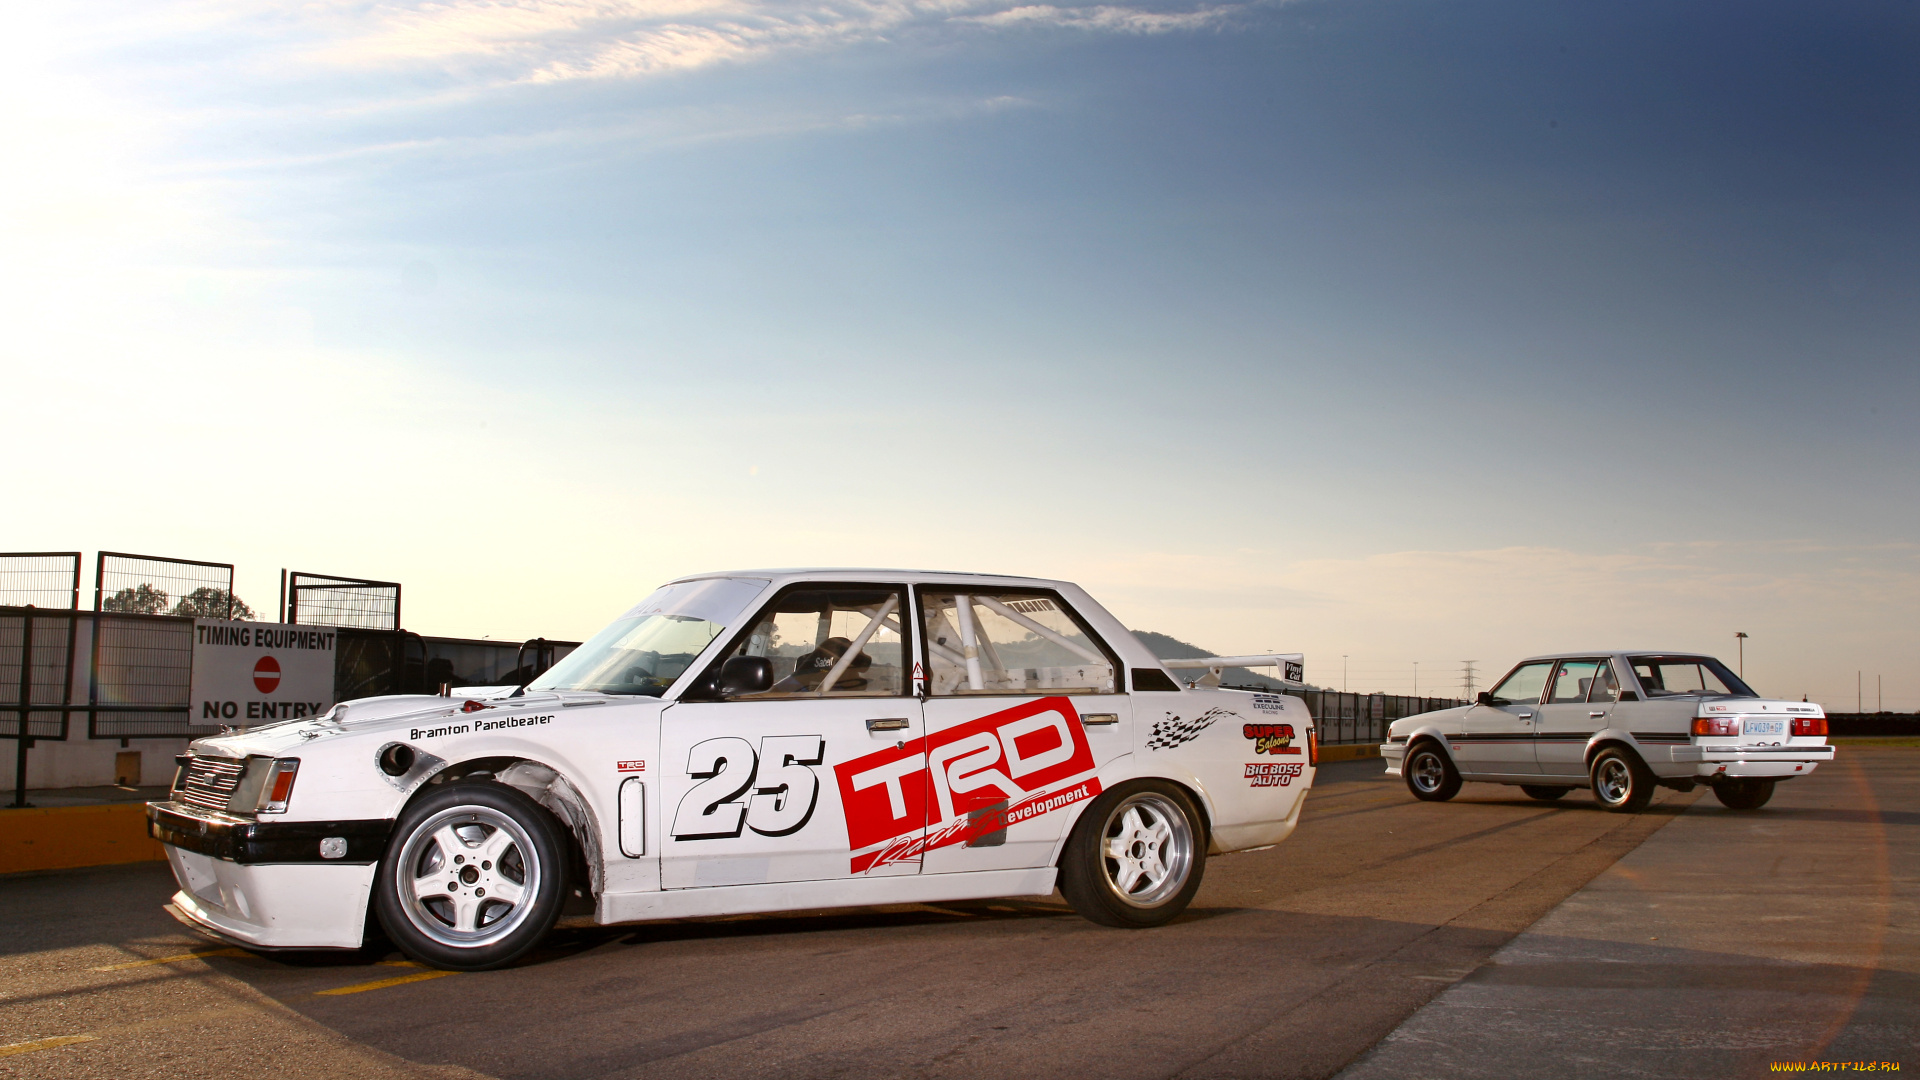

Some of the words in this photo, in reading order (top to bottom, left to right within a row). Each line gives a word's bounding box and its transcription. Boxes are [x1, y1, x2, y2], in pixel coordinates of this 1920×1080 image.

[197, 625, 250, 646] TIMING
[255, 628, 335, 650] EQUIPMENT
[203, 701, 238, 719] NO
[246, 701, 322, 719] ENTRY
[410, 725, 470, 740] Bramton
[474, 714, 556, 732] Panelbeater
[1244, 725, 1295, 738] SUPER
[617, 761, 644, 769] TRD
[851, 709, 1075, 823] TRD
[1270, 764, 1302, 775] BOSS
[670, 734, 826, 841] 25
[1252, 774, 1291, 786] AUTO
[997, 784, 1090, 826] Development
